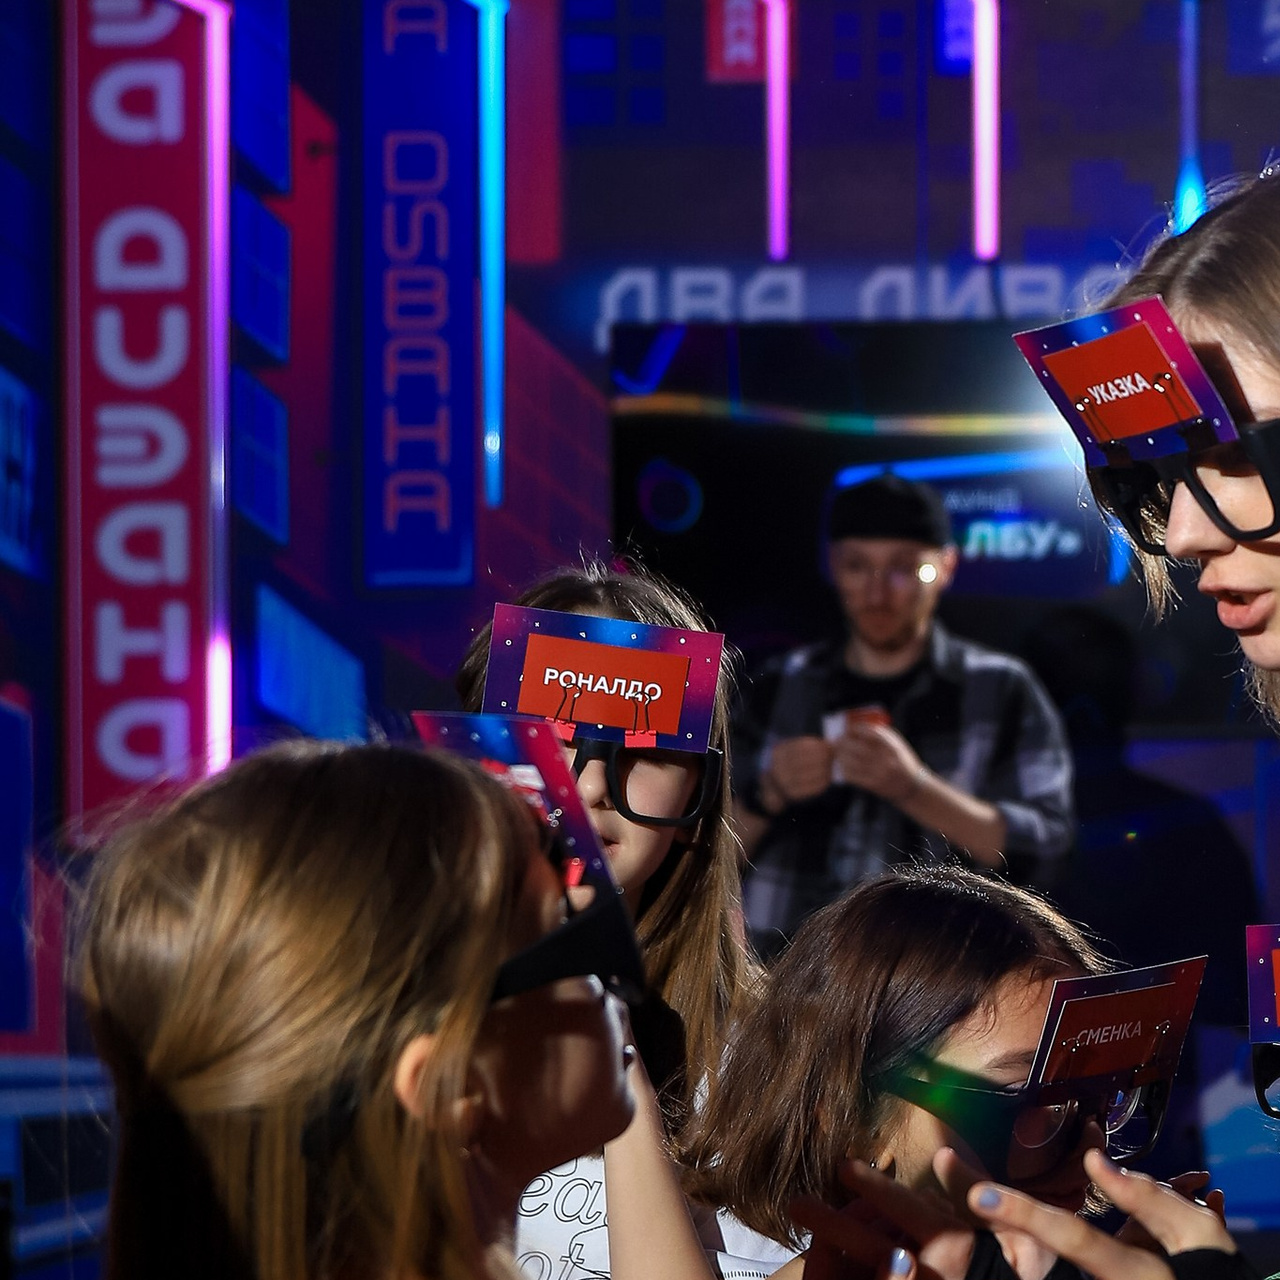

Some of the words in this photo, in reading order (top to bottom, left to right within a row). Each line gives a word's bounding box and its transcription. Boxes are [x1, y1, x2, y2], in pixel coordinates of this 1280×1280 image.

[1087, 372, 1152, 406] УКАЗКА
[543, 667, 662, 703] РОНАЛДО
[1076, 1020, 1143, 1048] СМЕНКА
[517, 1172, 608, 1226] ea
